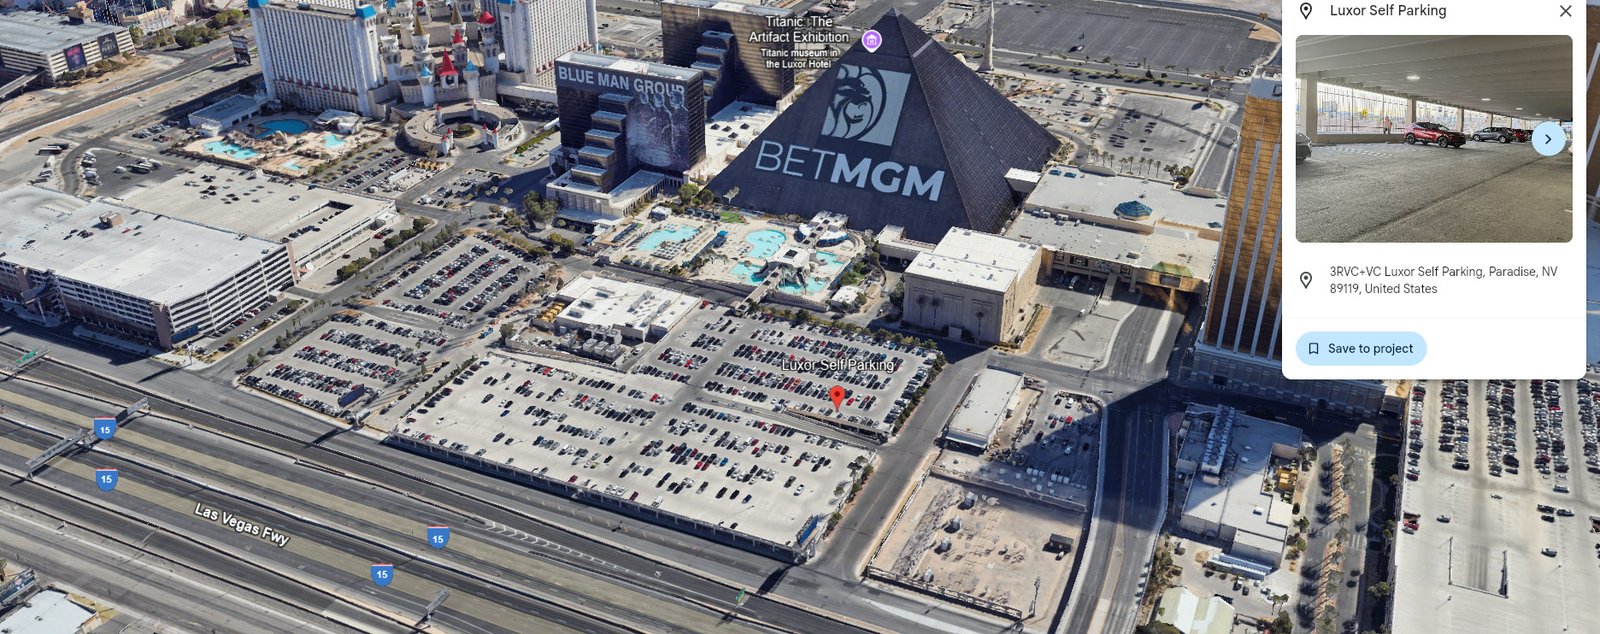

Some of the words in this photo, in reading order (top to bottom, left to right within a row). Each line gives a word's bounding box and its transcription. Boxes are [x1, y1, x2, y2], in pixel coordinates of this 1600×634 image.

[558, 66, 594, 85] BLUE
[598, 72, 630, 91] MAN
[755, 140, 945, 202] BETMGM
